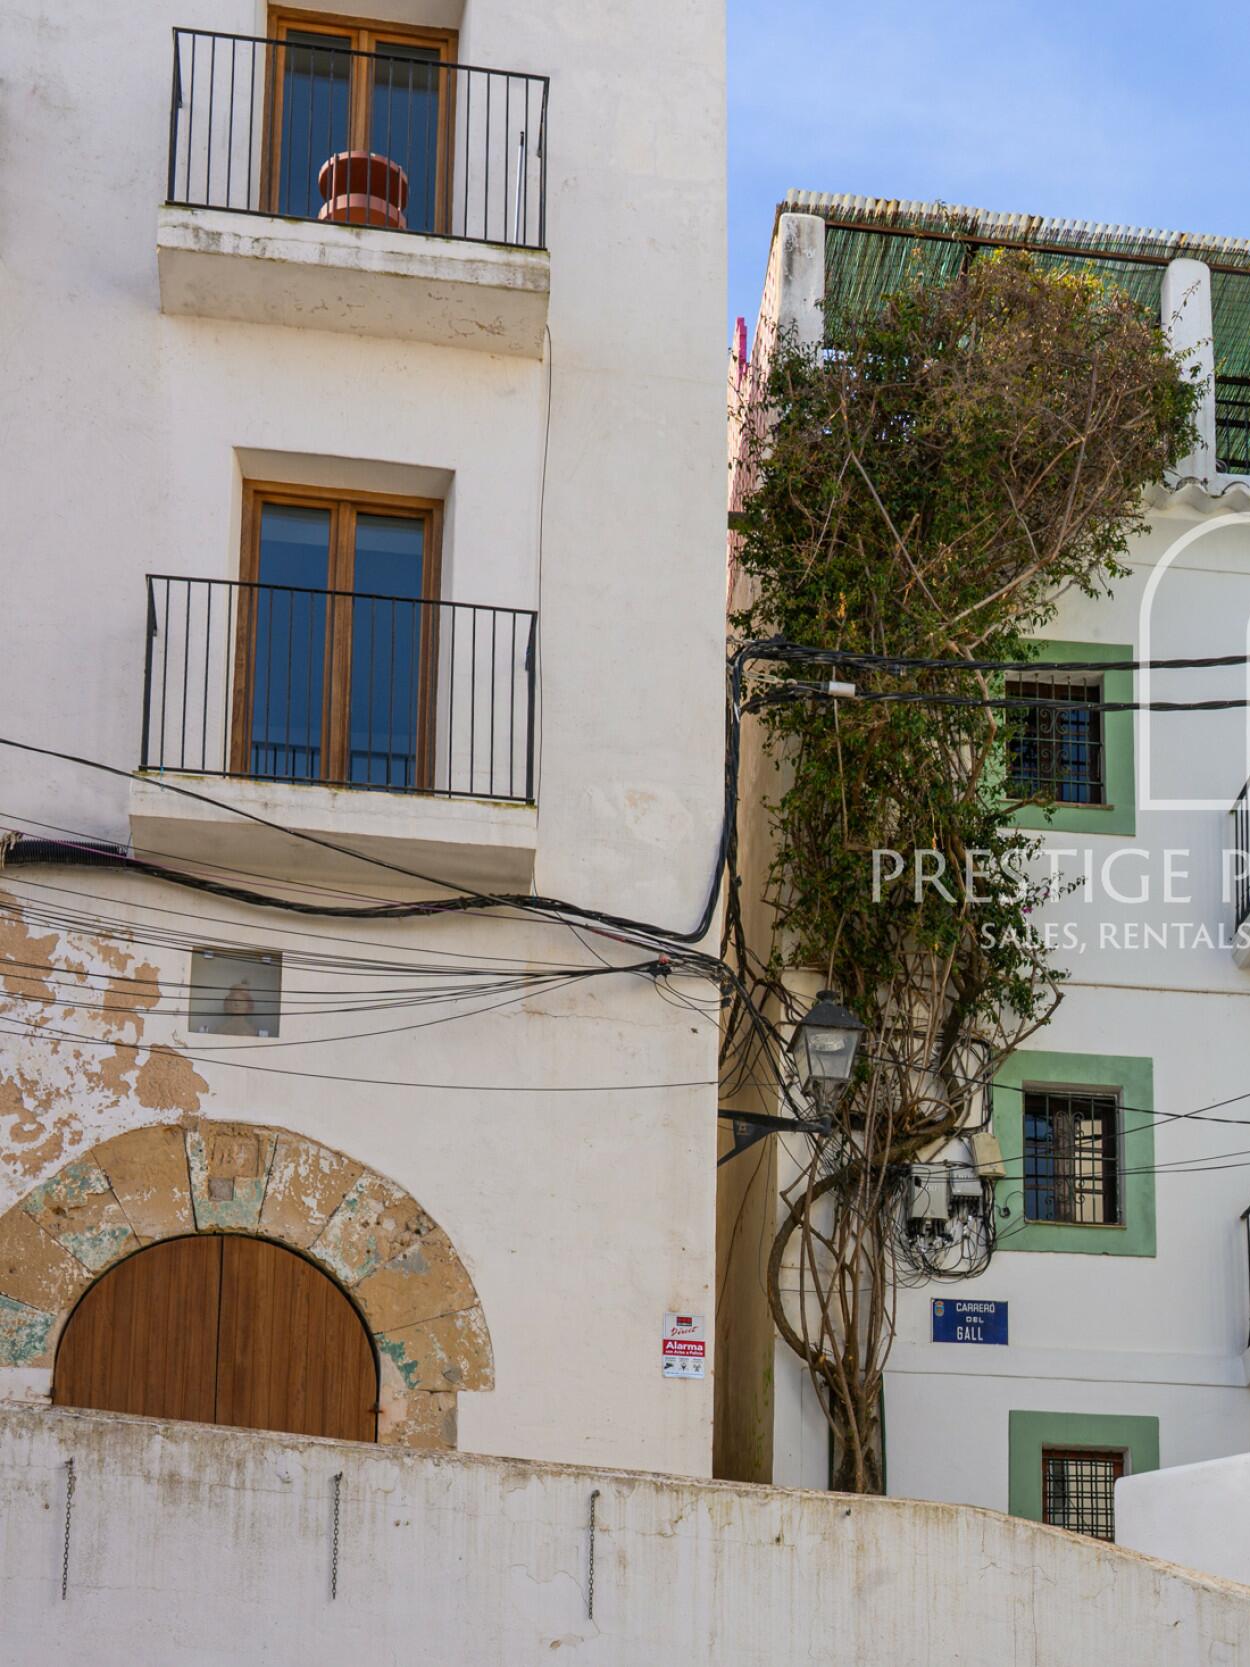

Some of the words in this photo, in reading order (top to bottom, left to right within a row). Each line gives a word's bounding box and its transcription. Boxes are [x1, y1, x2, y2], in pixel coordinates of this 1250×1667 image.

[966, 1316, 984, 1324] DEL
[957, 1326, 983, 1341] GALL
[666, 1341, 703, 1351] Alarma
